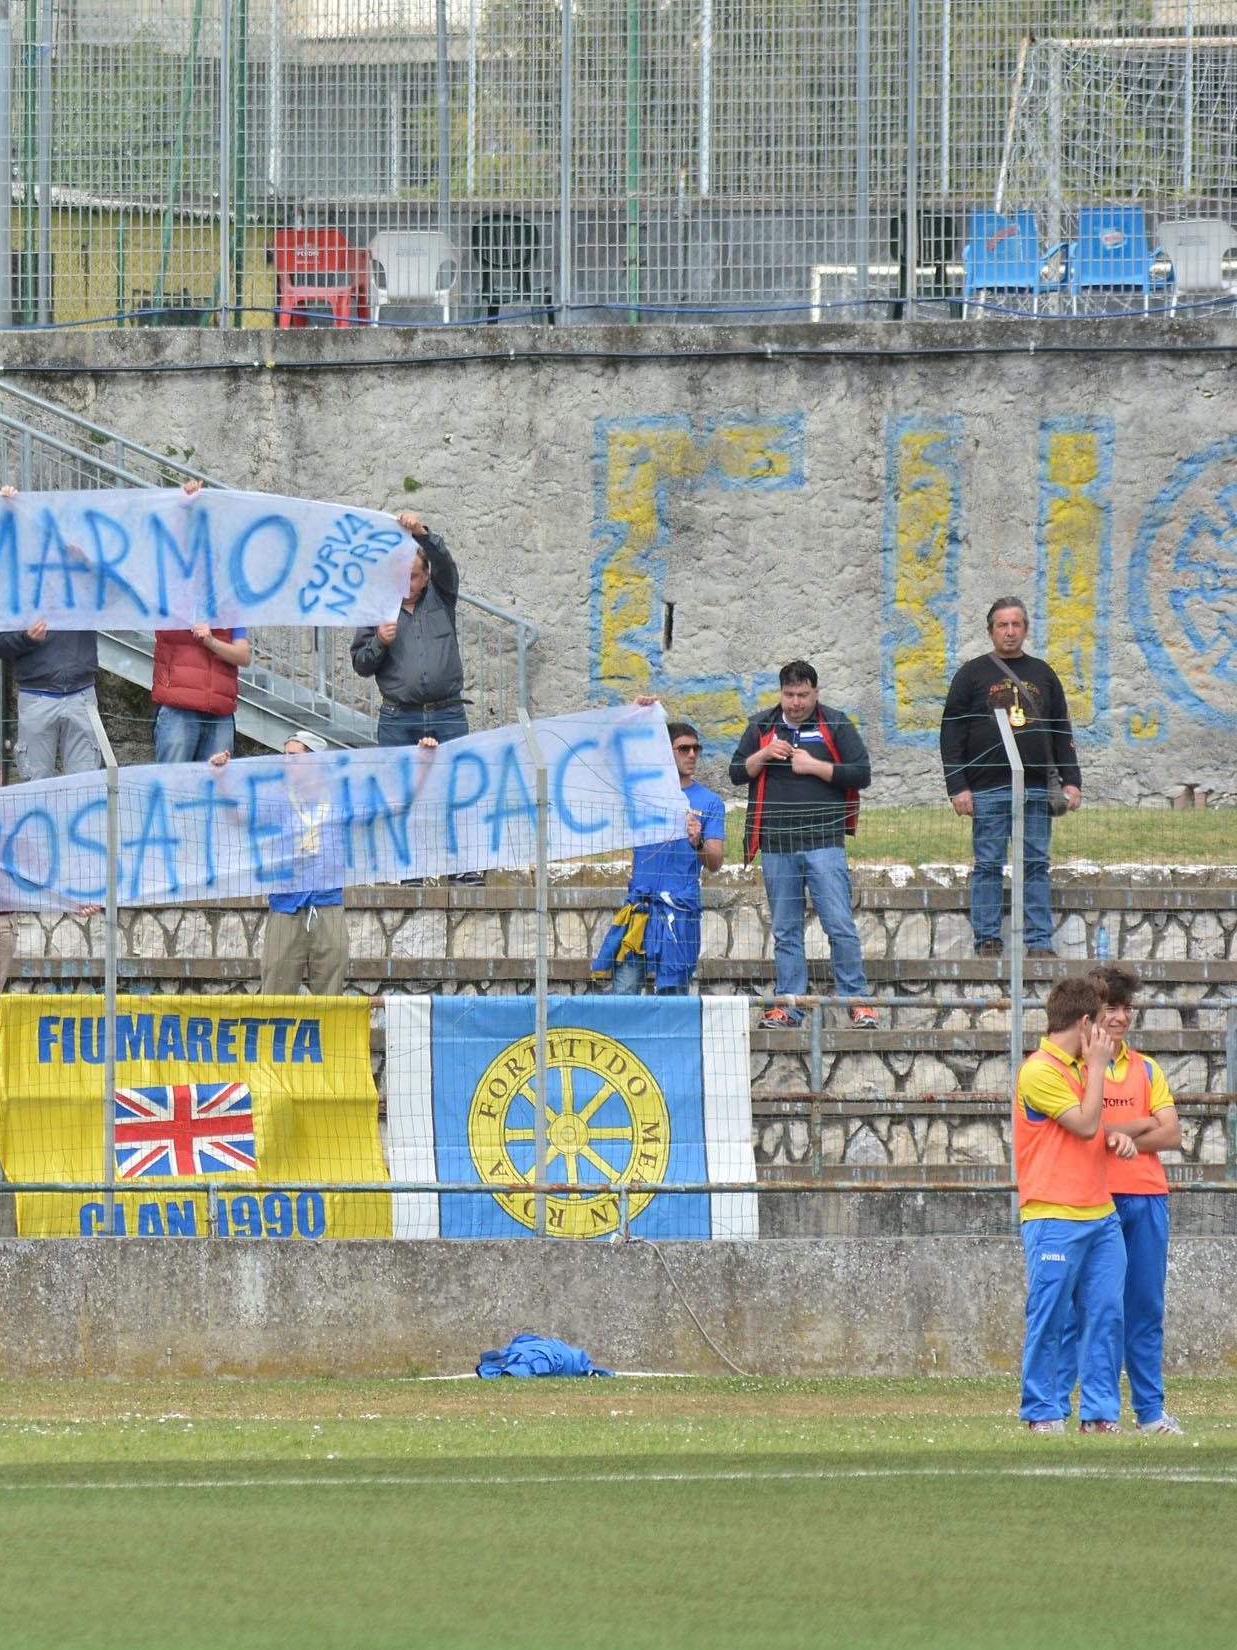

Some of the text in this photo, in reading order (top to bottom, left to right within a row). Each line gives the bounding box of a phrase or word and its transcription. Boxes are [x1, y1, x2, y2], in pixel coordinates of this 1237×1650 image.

[298, 513, 374, 613] CURVA
[325, 531, 403, 616] NORD
[446, 726, 667, 856] PACE
[37, 1013, 323, 1065] FIUMARETTA
[217, 1189, 326, 1239] 1990
